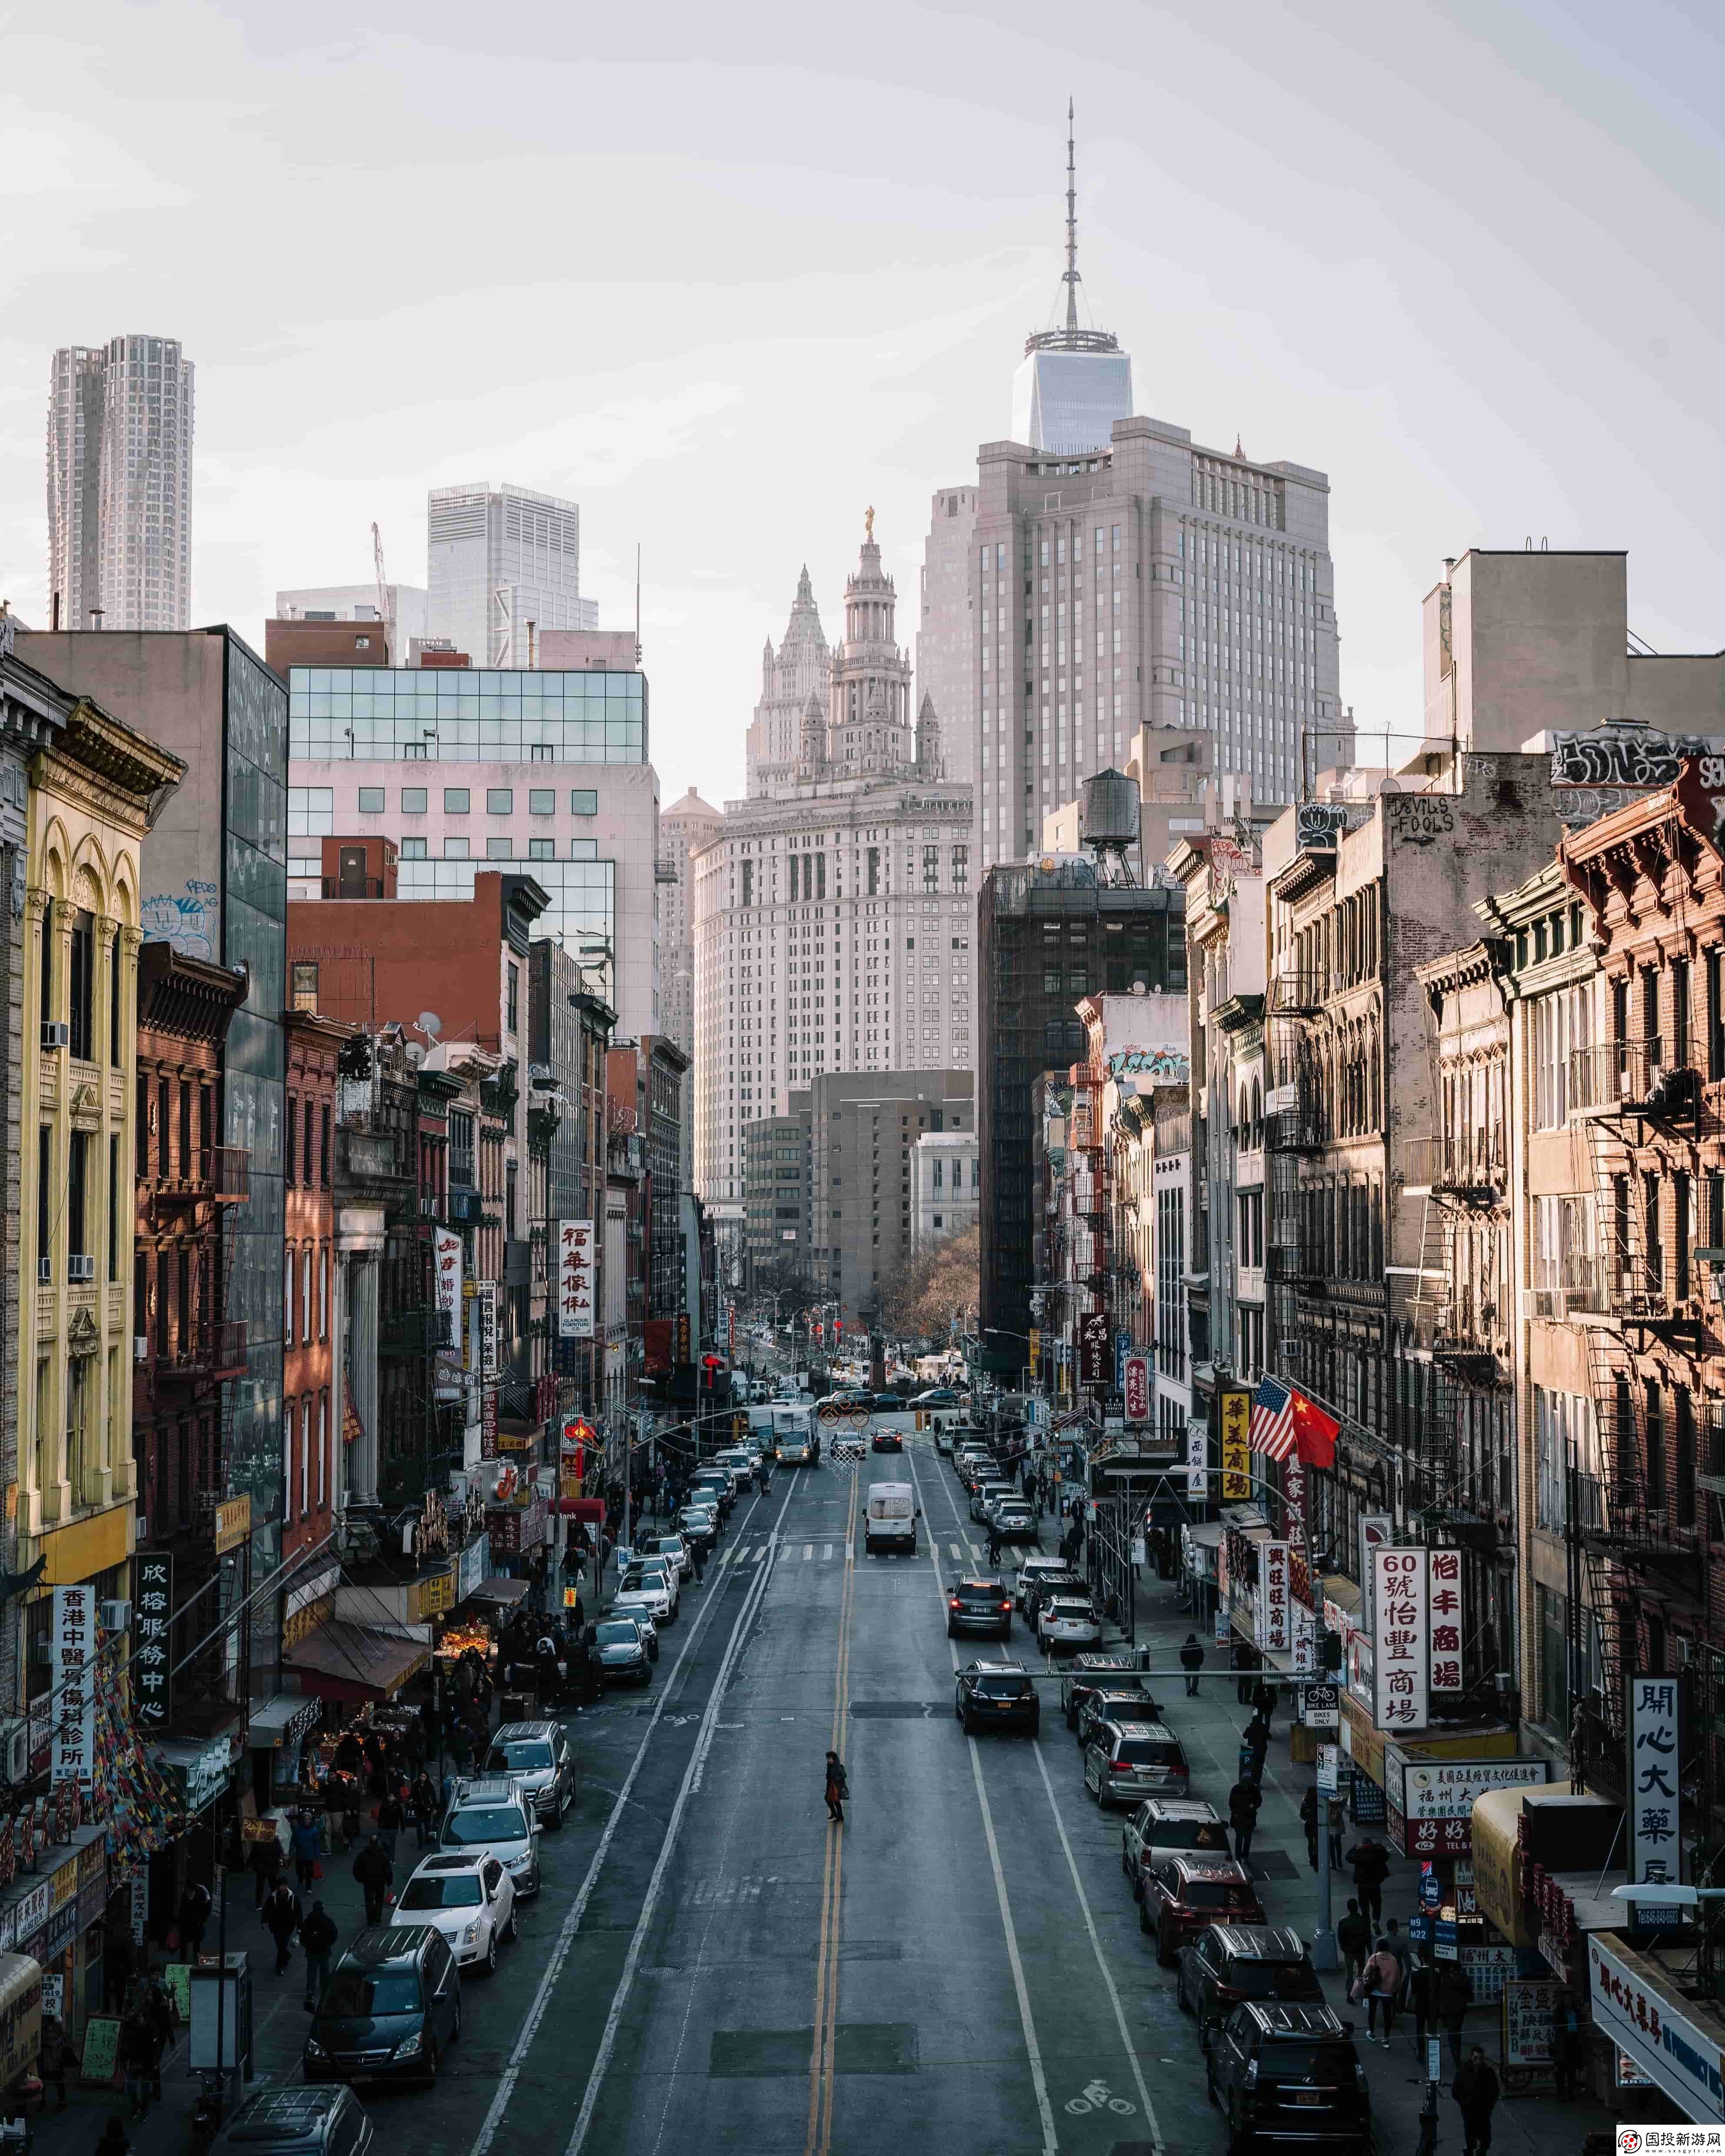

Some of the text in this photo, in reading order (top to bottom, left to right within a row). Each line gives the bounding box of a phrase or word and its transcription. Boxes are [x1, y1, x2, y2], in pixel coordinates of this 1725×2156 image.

[1399, 814, 1454, 833] FOOLS
[562, 1228, 591, 1314] 福華傢俬
[1128, 1366, 1139, 1412] 漂亮人生
[1191, 1440, 1203, 1487] 西餅屋
[1224, 1398, 1247, 1496] 華美商場
[1267, 1548, 1286, 1648] 興旺旺商場
[139, 1565, 168, 1718] 欣榕服務中心
[60, 1589, 86, 1766] 香港中醫骨傷科診所
[1418, 1786, 1486, 1803] 福州大
[1418, 1820, 1472, 1840] 好好
[1446, 1842, 1461, 1850] TEL
[1410, 1918, 1421, 1927] M9
[1410, 1930, 1426, 1939] M22
[1519, 1987, 1558, 2010] 金盛
